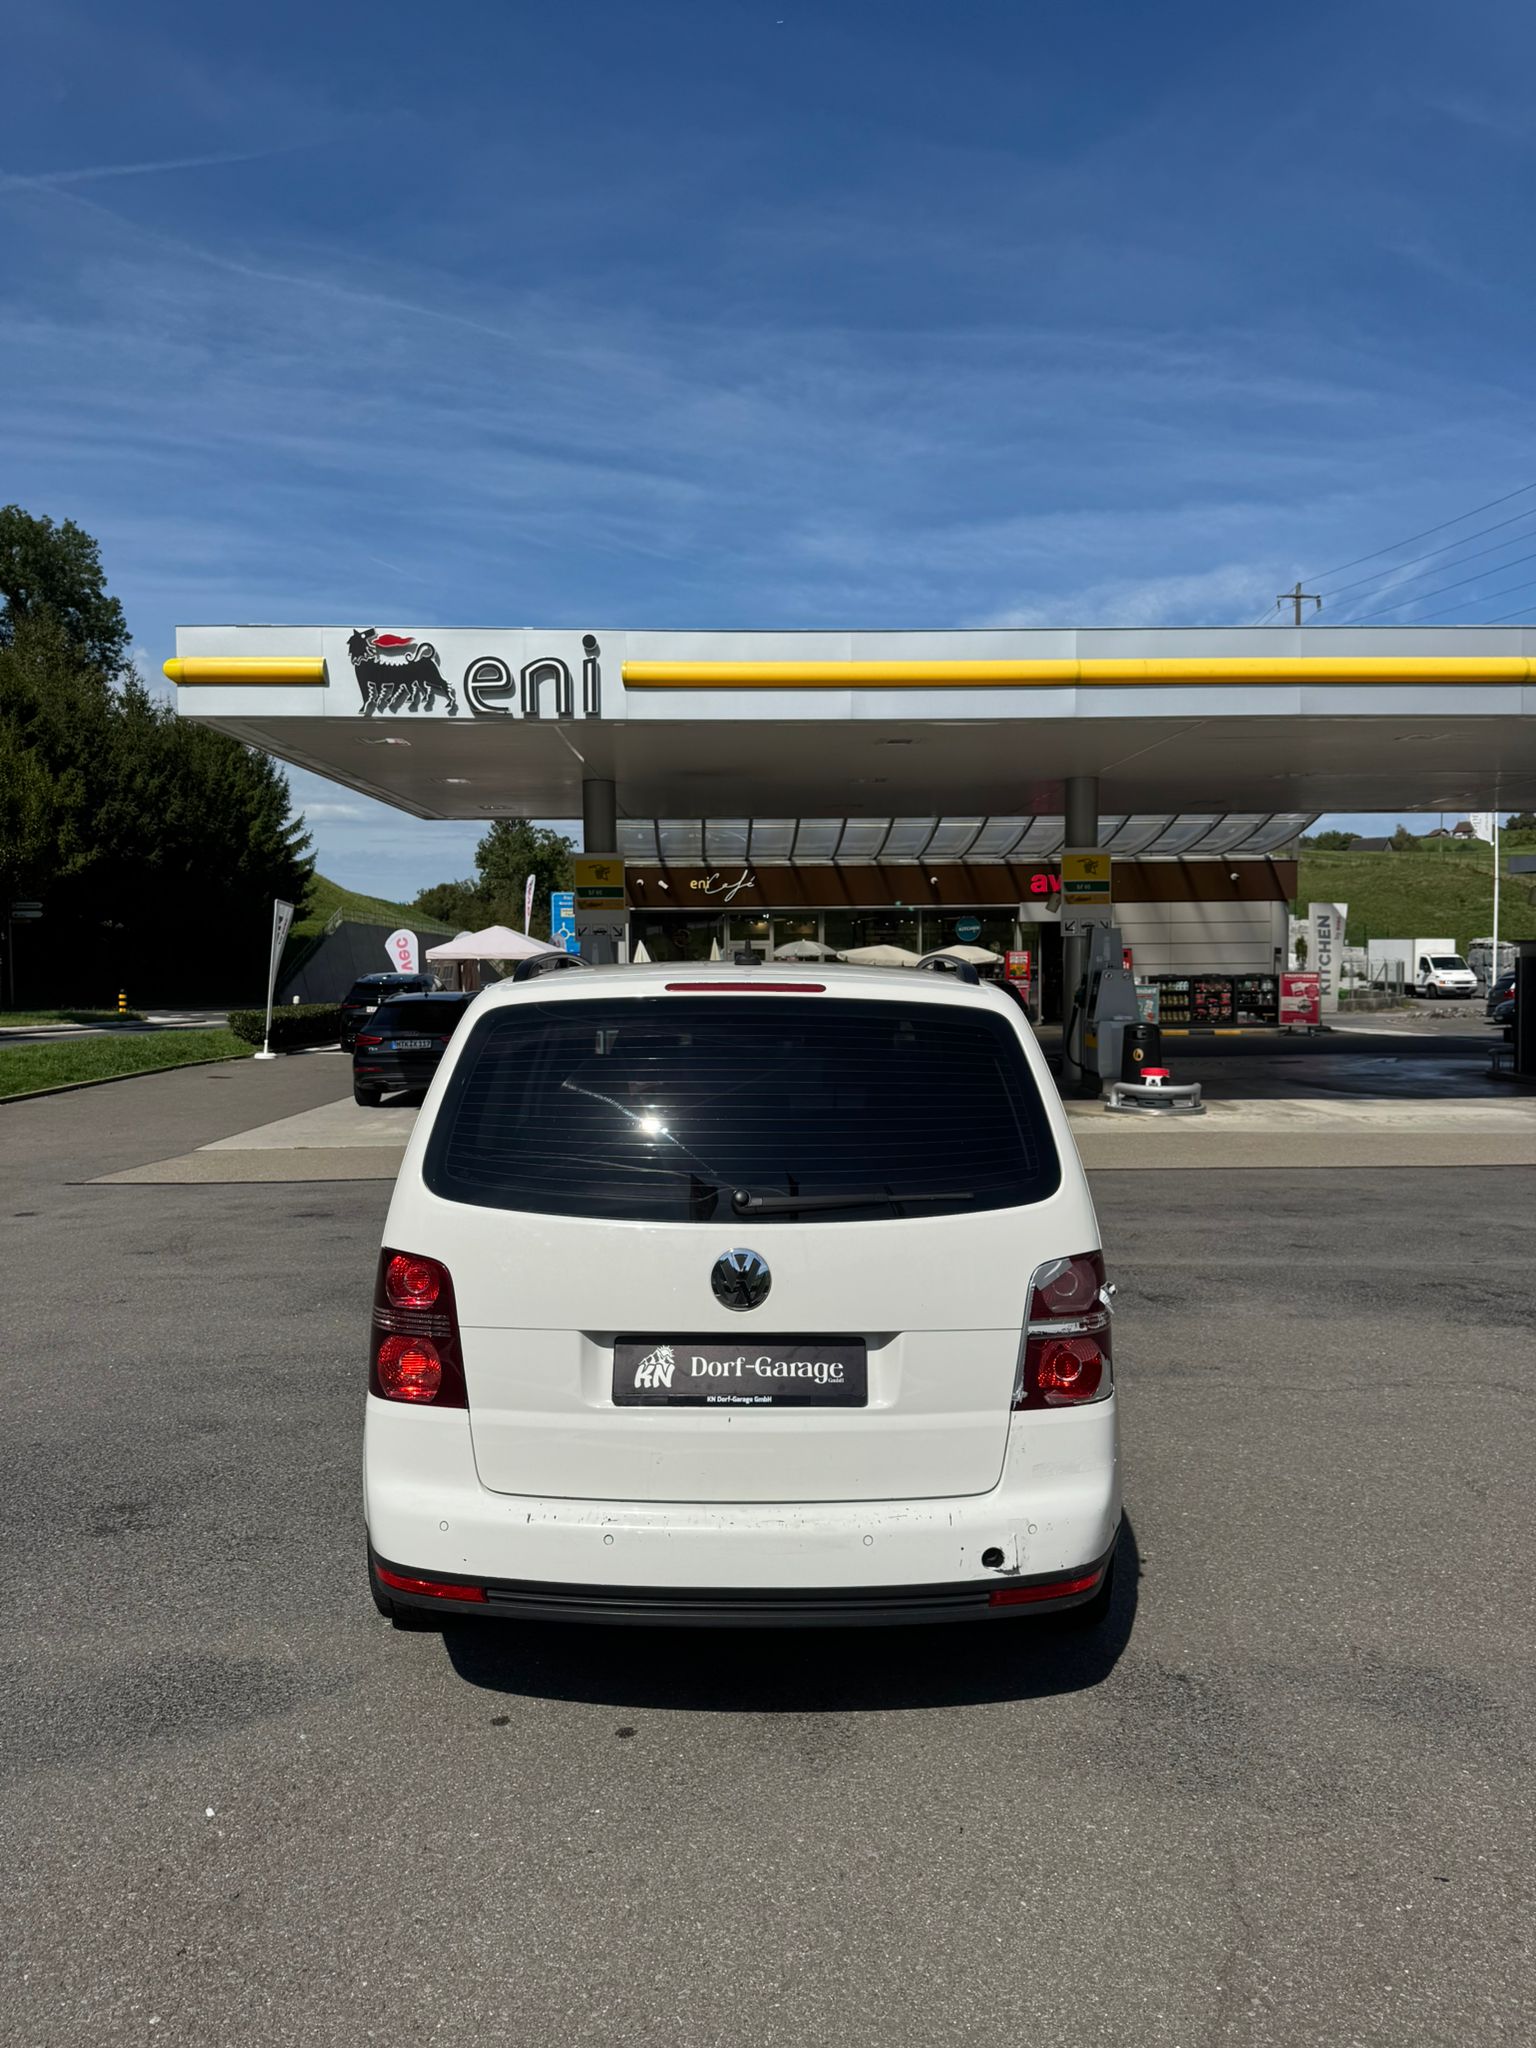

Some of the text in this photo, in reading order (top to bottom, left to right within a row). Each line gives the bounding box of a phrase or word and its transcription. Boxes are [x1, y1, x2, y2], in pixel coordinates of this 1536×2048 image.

[463, 634, 599, 714] eni
[690, 877, 709, 889] eni
[1030, 874, 1062, 893] av
[396, 937, 413, 971] vec
[1317, 915, 1332, 996] KITCHEN
[634, 1356, 845, 1388] KN Dorf-Garage
[717, 1396, 753, 1404] Dorf-Garage
